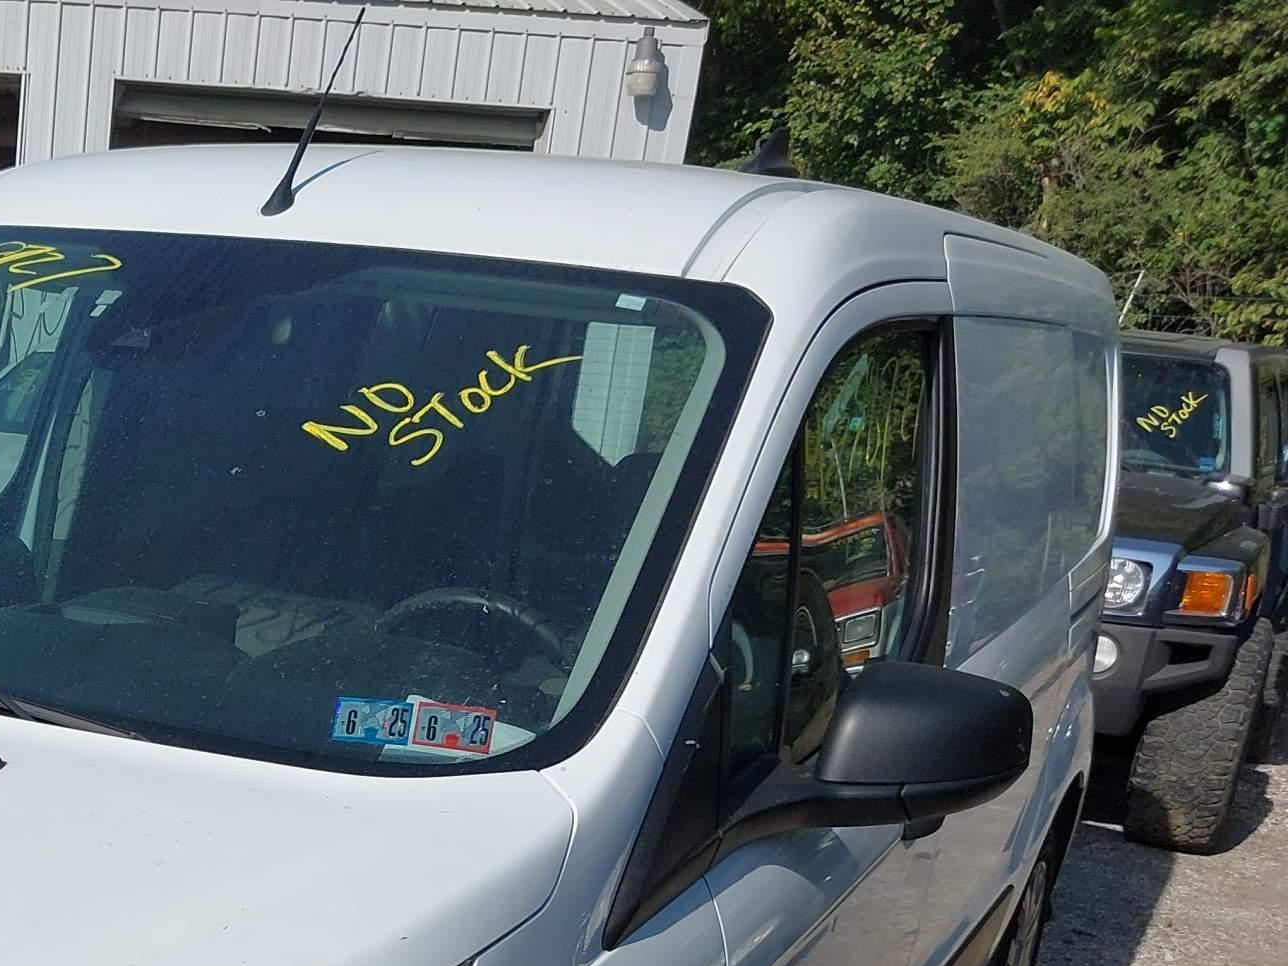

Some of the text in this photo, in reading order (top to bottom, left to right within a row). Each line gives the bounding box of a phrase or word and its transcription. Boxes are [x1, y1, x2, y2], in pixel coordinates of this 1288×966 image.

[302, 382, 415, 451] NO
[388, 344, 584, 466] STOCK
[1136, 405, 1169, 432] NO
[1160, 391, 1209, 439] STOCK
[345, 707, 409, 738] 6 25
[425, 715, 491, 746] 6 25
